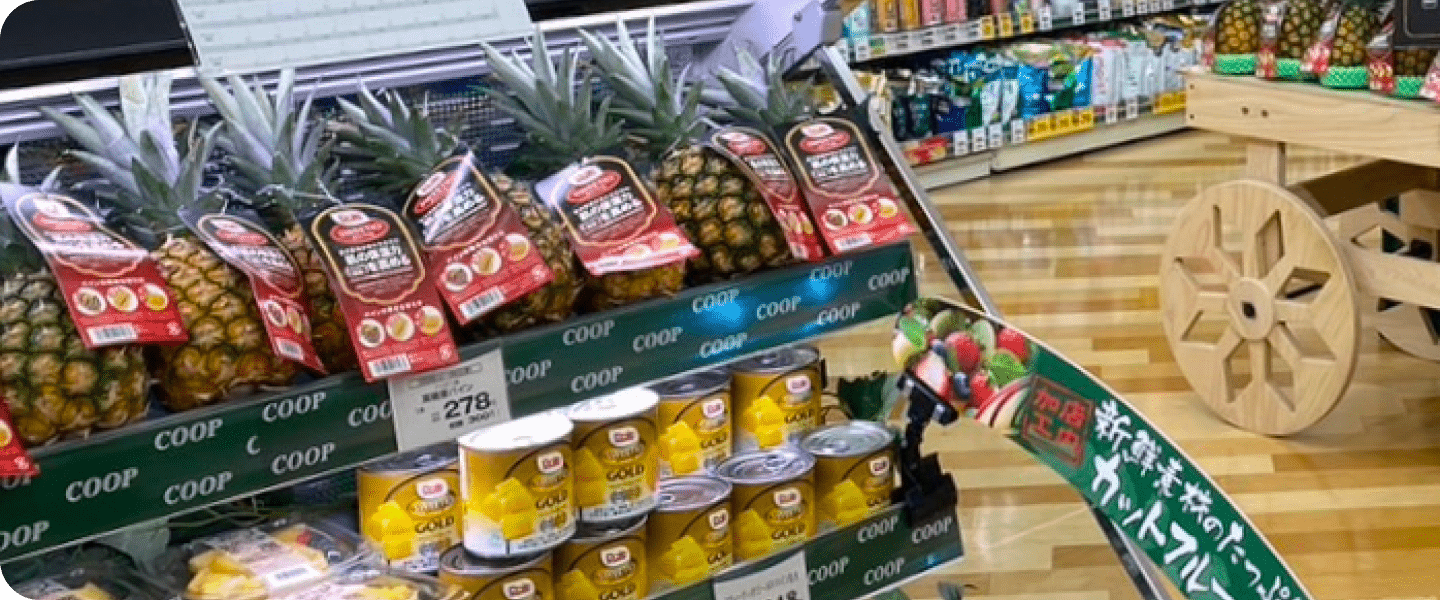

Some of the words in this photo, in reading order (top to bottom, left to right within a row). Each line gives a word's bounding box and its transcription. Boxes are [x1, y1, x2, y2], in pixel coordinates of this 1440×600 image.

[809, 260, 853, 281] COOP
[868, 266, 911, 291] COOP
[692, 288, 740, 314] COOP
[756, 295, 802, 320] COOP
[817, 302, 861, 326] COOP
[562, 319, 616, 346] COOP
[632, 326, 684, 353] COOP
[699, 332, 748, 359] COOP
[570, 365, 624, 394] COOP
[262, 391, 327, 422] COOP
[348, 400, 392, 427] COO
[443, 392, 491, 419] 278
[154, 418, 223, 450] COOP
[271, 441, 336, 475] COOP
[65, 466, 139, 503] COOP
[606, 464, 646, 482] GOLD
[163, 471, 234, 505] COOP
[0, 519, 50, 552] OOP
[414, 515, 456, 534] GOLD
[857, 514, 899, 544] COOP
[911, 515, 953, 544] COOP
[808, 555, 849, 586] COOP
[863, 557, 905, 586] COOP
